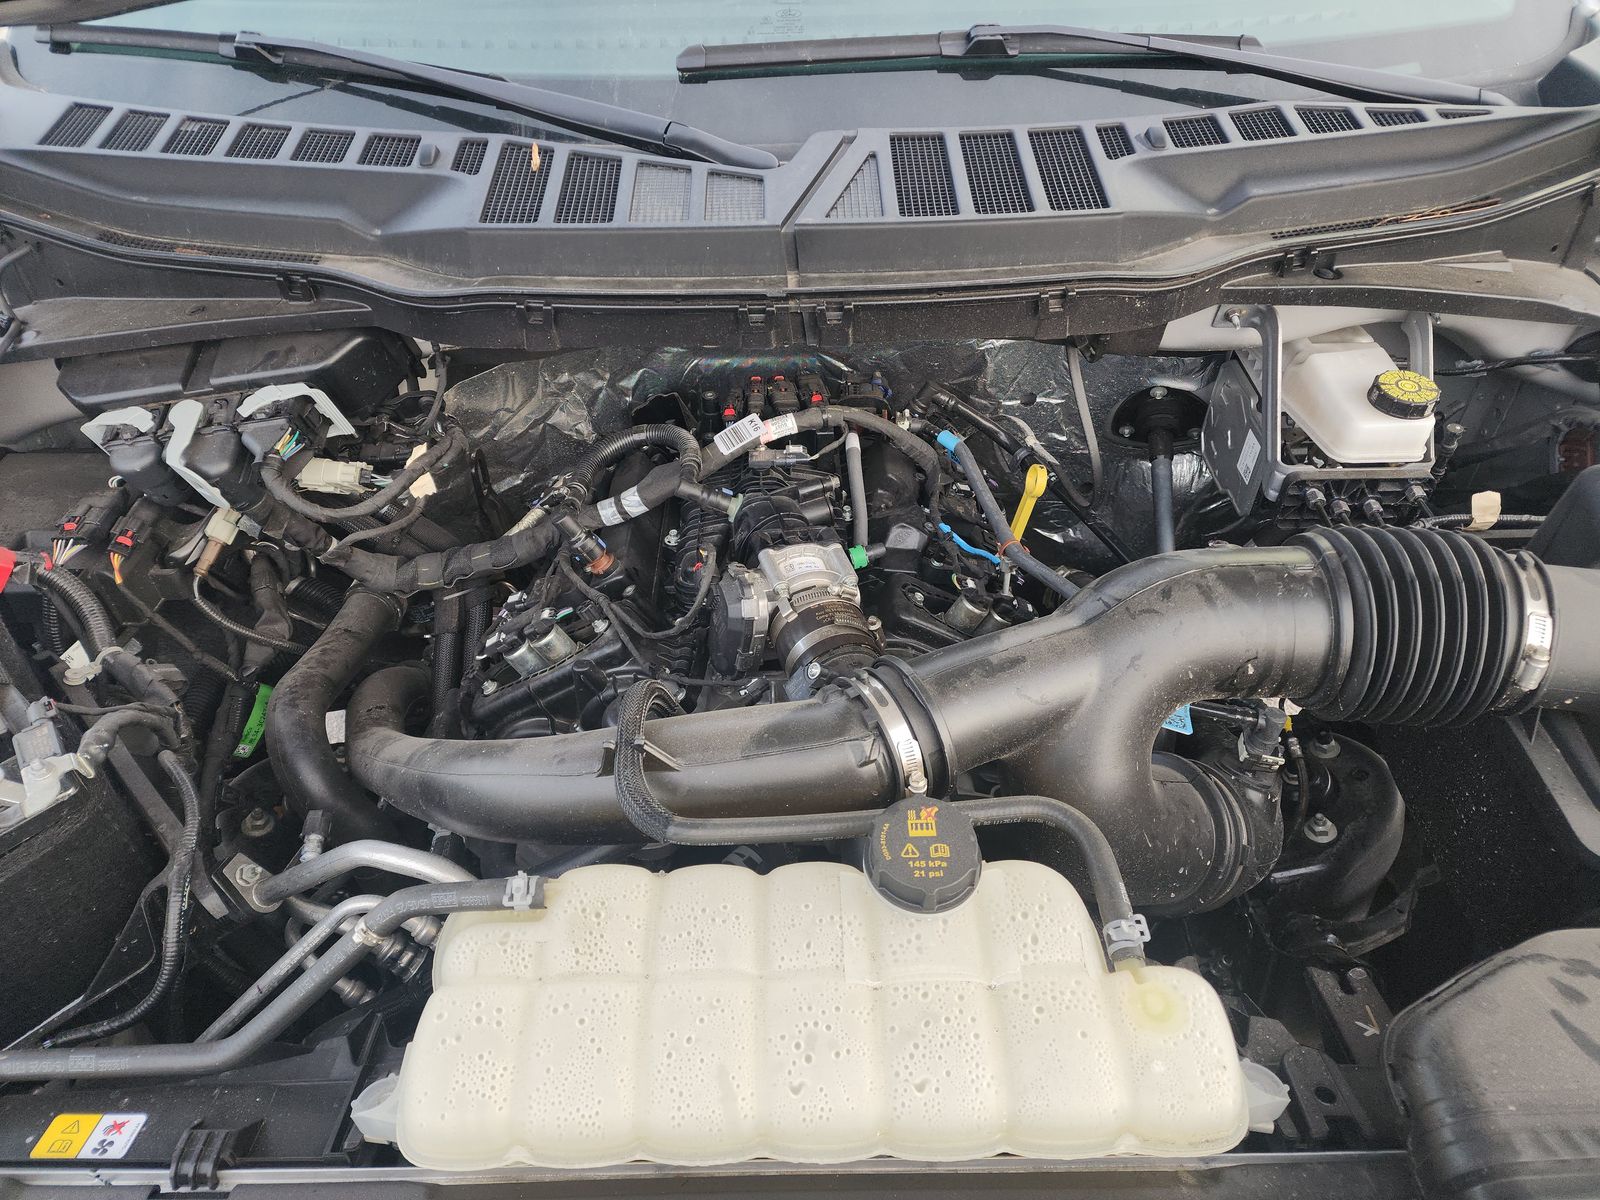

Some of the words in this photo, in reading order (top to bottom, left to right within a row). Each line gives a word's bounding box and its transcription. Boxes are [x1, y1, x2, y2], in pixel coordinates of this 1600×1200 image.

[747, 418, 761, 432] K16
[908, 860, 926, 868] 145
[928, 860, 947, 868] kPa
[913, 870, 925, 878] 21
[928, 870, 944, 879] psi
